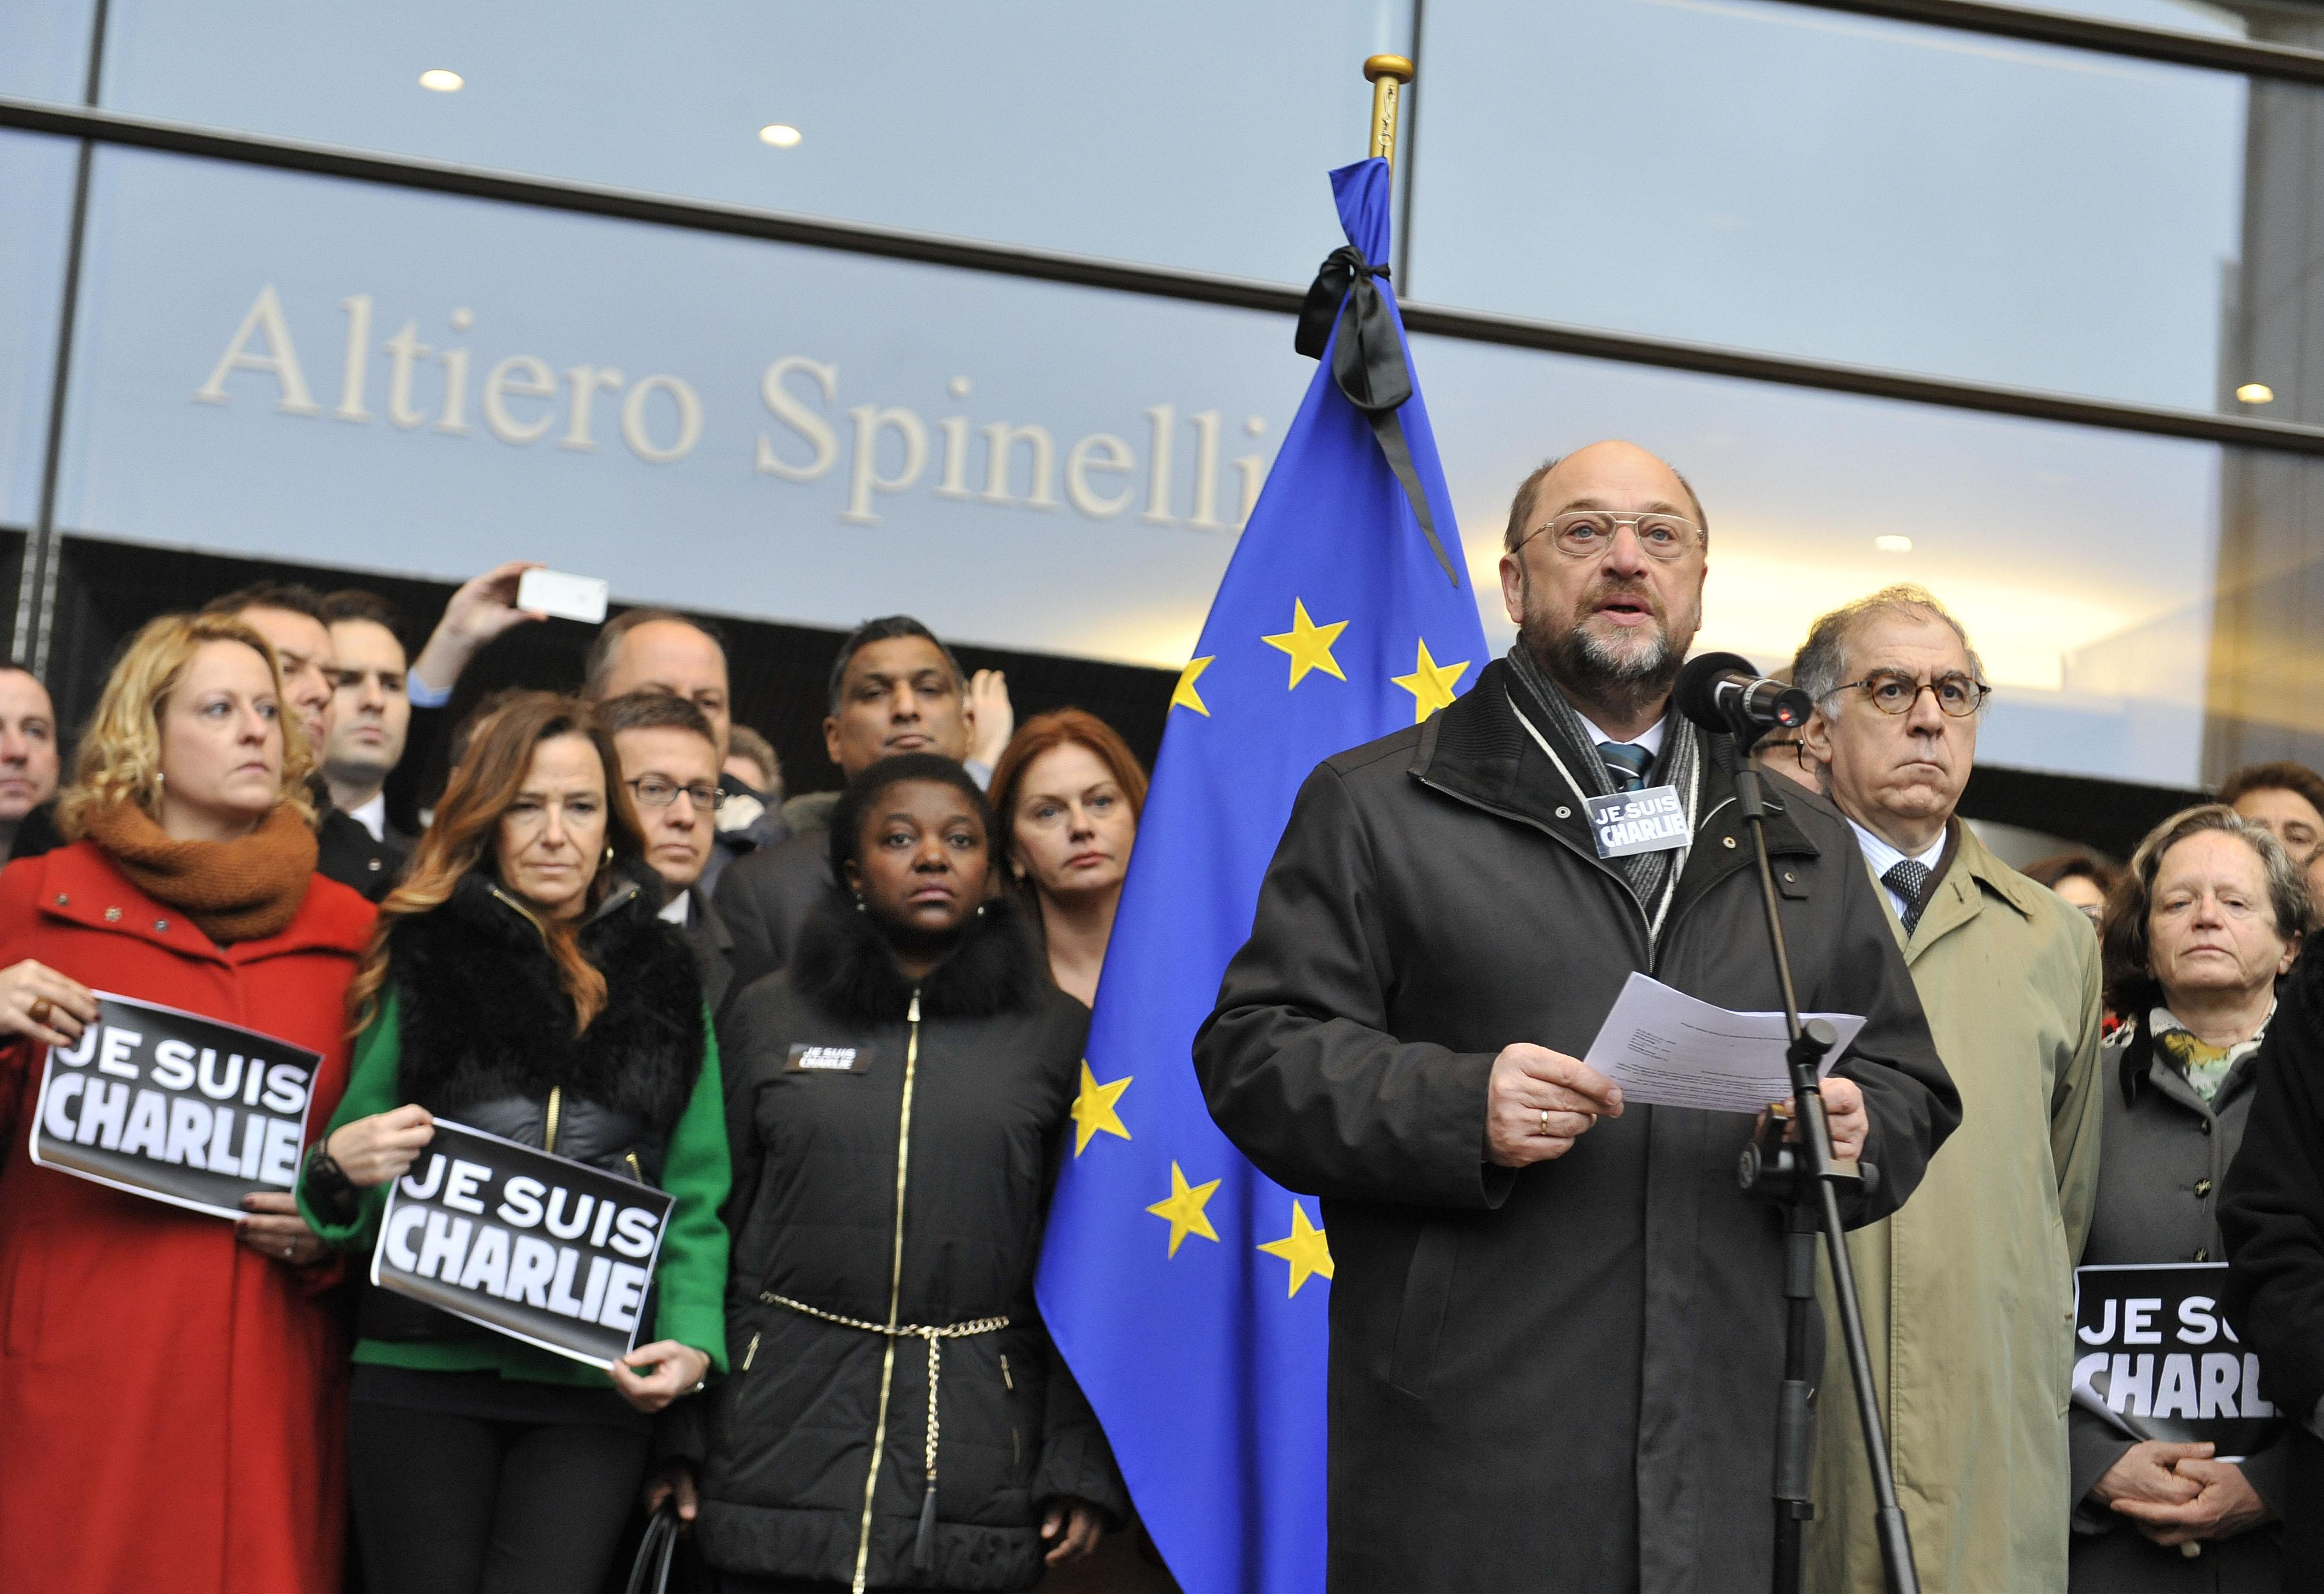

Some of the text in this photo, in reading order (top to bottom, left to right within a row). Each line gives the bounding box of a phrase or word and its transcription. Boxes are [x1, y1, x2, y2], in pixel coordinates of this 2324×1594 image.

[190, 284, 1267, 535] Altiero Spinelli
[1596, 795, 1678, 825] JE SUIS
[1601, 813, 1686, 847] CHARLIE
[55, 1022, 309, 1113] JE SUIS
[803, 1046, 856, 1059] JE SUIS
[44, 1072, 301, 1187] CHARLIE
[400, 1153, 659, 1258] JE SUIS
[385, 1205, 648, 1332] CHARLIE
[2078, 1296, 2240, 1345] JE S
[2072, 1352, 2285, 1418] CHARL
